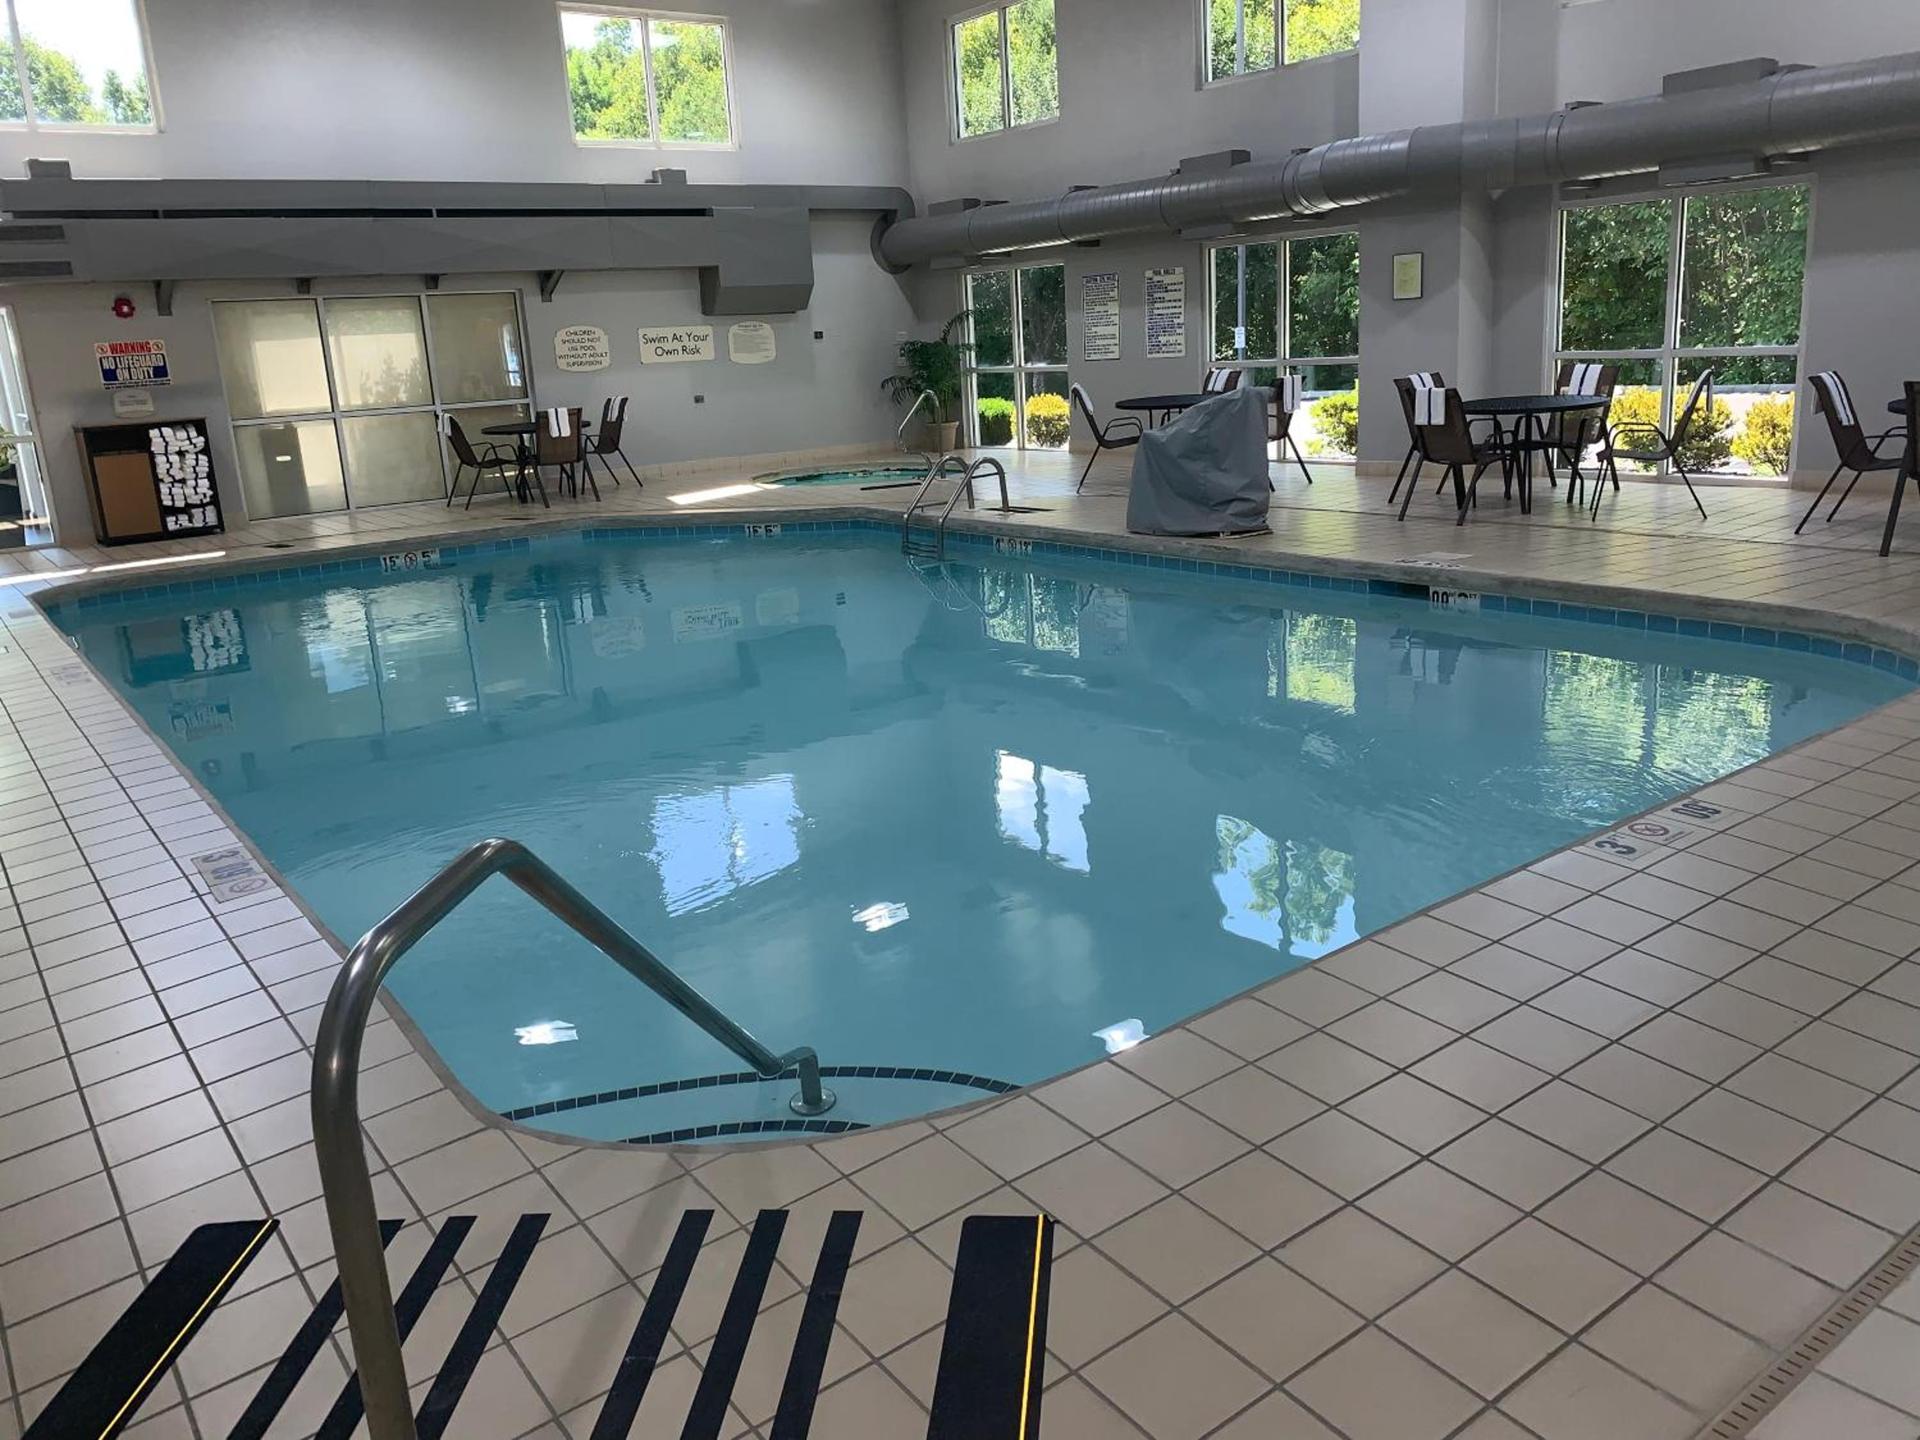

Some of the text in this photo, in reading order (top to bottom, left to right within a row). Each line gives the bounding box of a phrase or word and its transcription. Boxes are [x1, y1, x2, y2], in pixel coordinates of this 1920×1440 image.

[565, 329, 596, 337] CHILDREN
[642, 330, 709, 345] Swim At Your
[108, 341, 152, 355] WARNING
[655, 344, 702, 357] Own Risk
[101, 354, 164, 369] NO LIFEGUARD
[116, 366, 154, 381] ON DUTY
